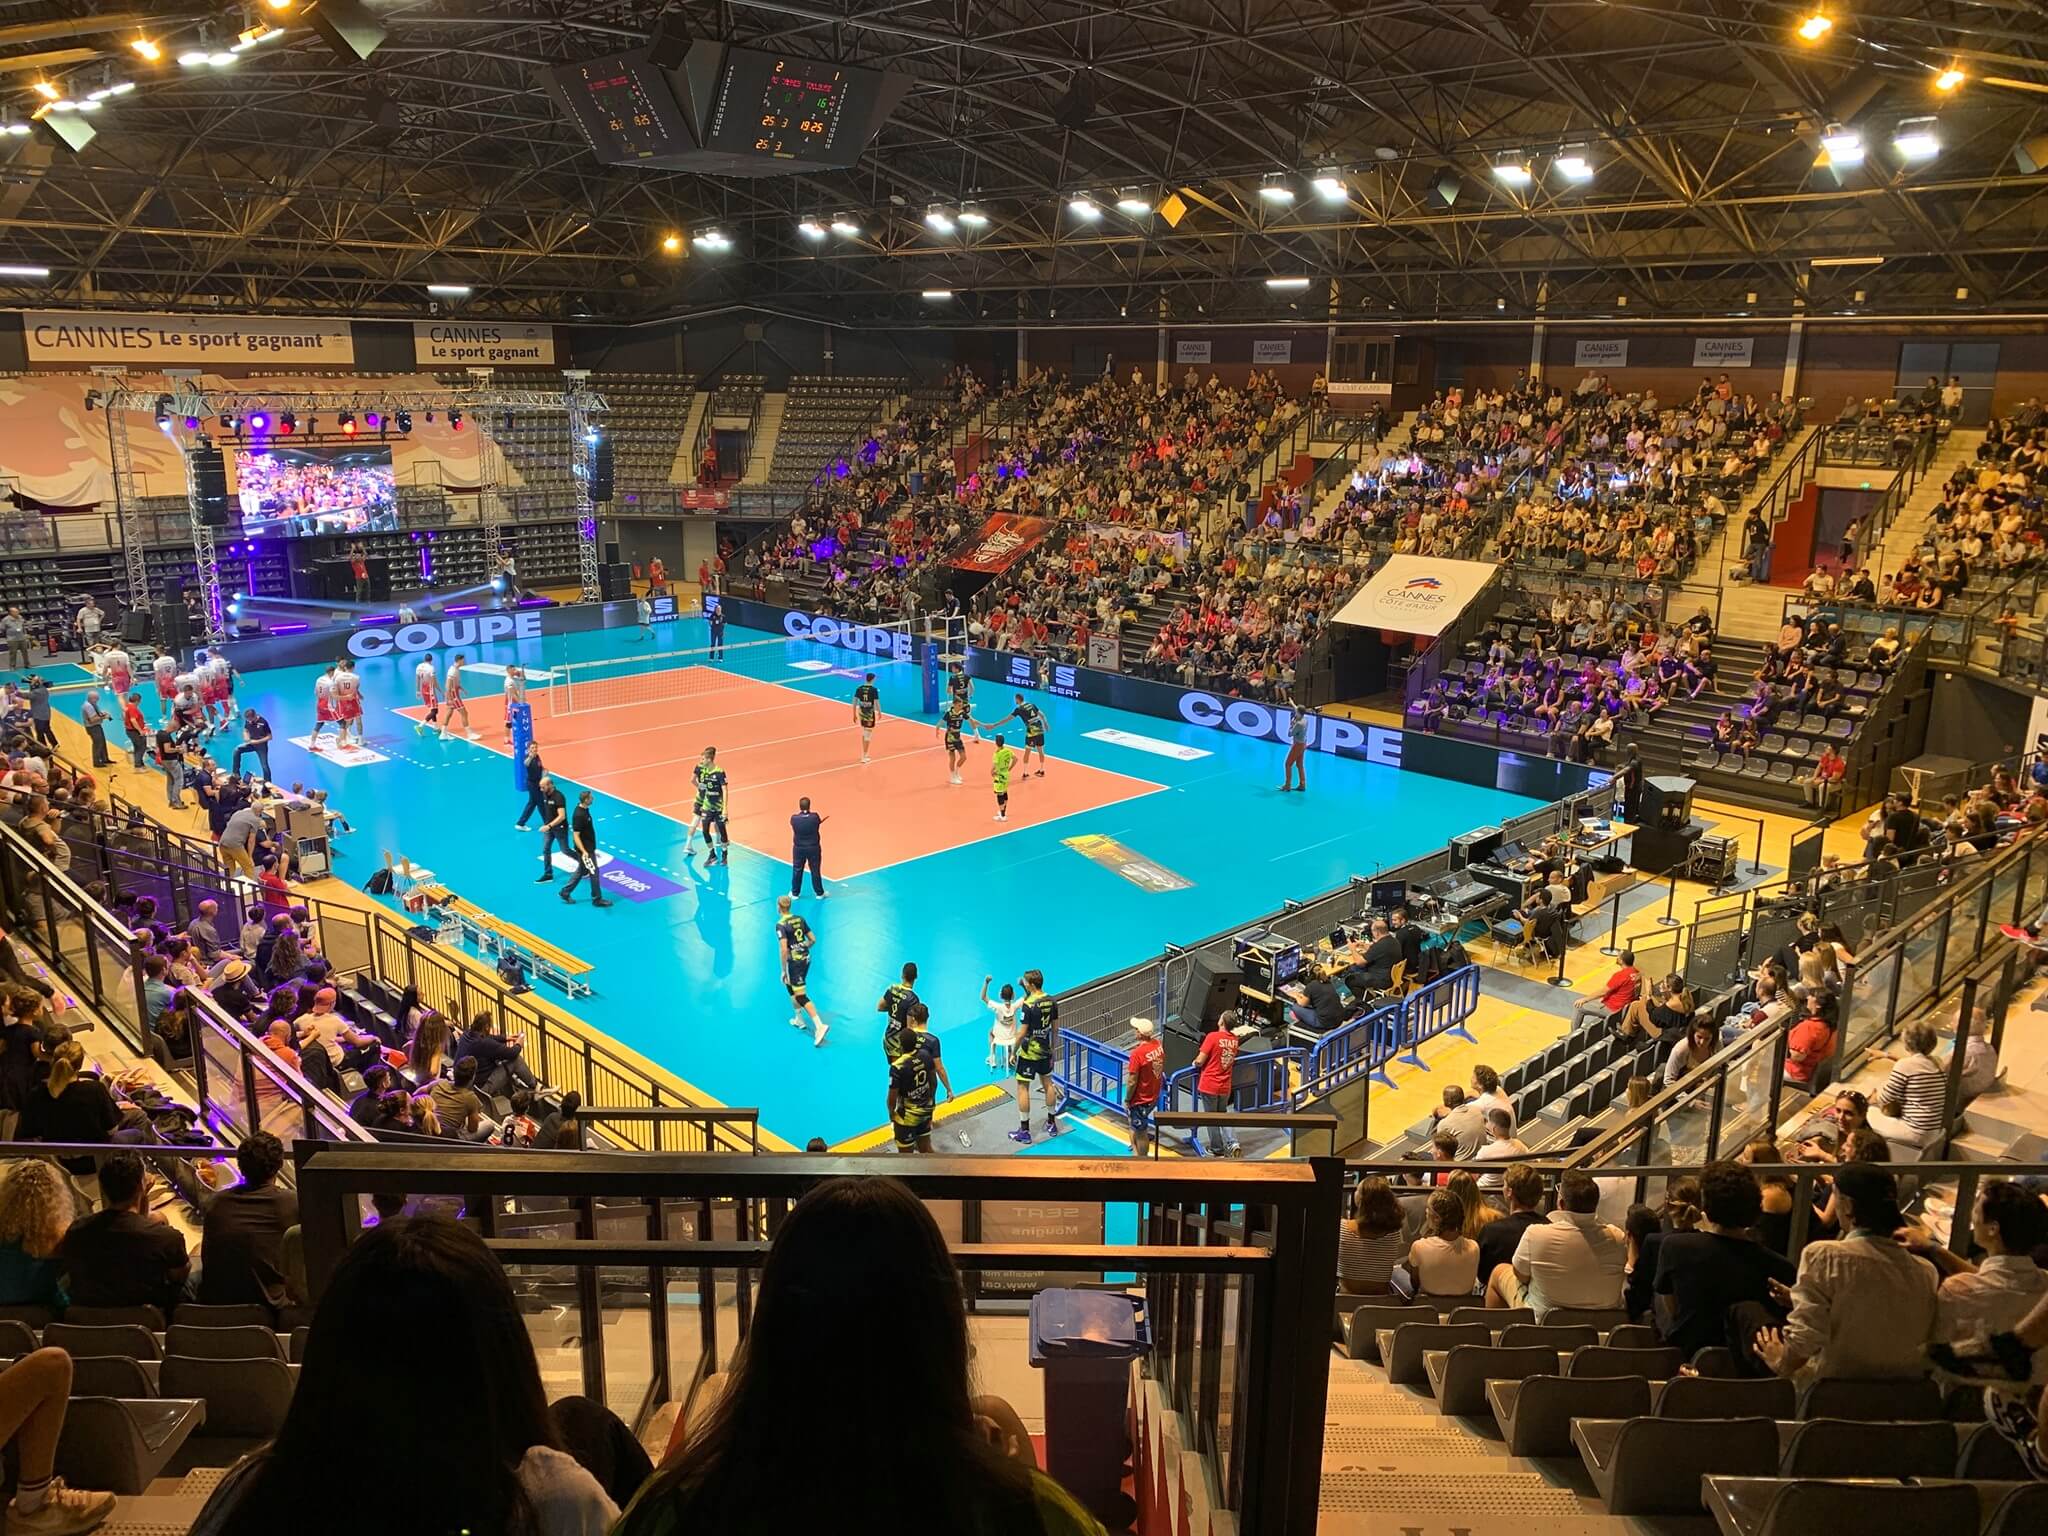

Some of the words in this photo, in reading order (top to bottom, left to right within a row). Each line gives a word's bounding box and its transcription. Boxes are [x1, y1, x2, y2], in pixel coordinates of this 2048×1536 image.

[776, 61, 784, 72] 2
[817, 98, 826, 108] 16
[762, 115, 775, 126] 25
[810, 122, 824, 133] 25
[755, 139, 769, 150] 25
[34, 325, 153, 349] CANNES
[159, 330, 185, 346] Le
[188, 332, 242, 351] sport
[247, 333, 323, 352] gagnant
[430, 327, 502, 344] CANNES
[1182, 343, 1206, 352] CANNES
[1259, 343, 1286, 352] CANNES
[1584, 343, 1619, 352] CANNES
[1704, 342, 1744, 351] CANNES
[432, 346, 448, 357] Le
[450, 346, 486, 359] sport
[488, 346, 540, 361] gagnant
[1387, 588, 1447, 603] CANNES
[649, 614, 679, 623] SEAT
[347, 611, 541, 658] COUPE
[783, 611, 913, 662] COUPE
[343, 682, 351, 690] 10
[1006, 675, 1037, 687] SEAT
[1049, 685, 1081, 698] SEAT
[1178, 691, 1403, 767] COUPE
[602, 870, 652, 893] Cannes
[913, 1069, 927, 1088] 10
